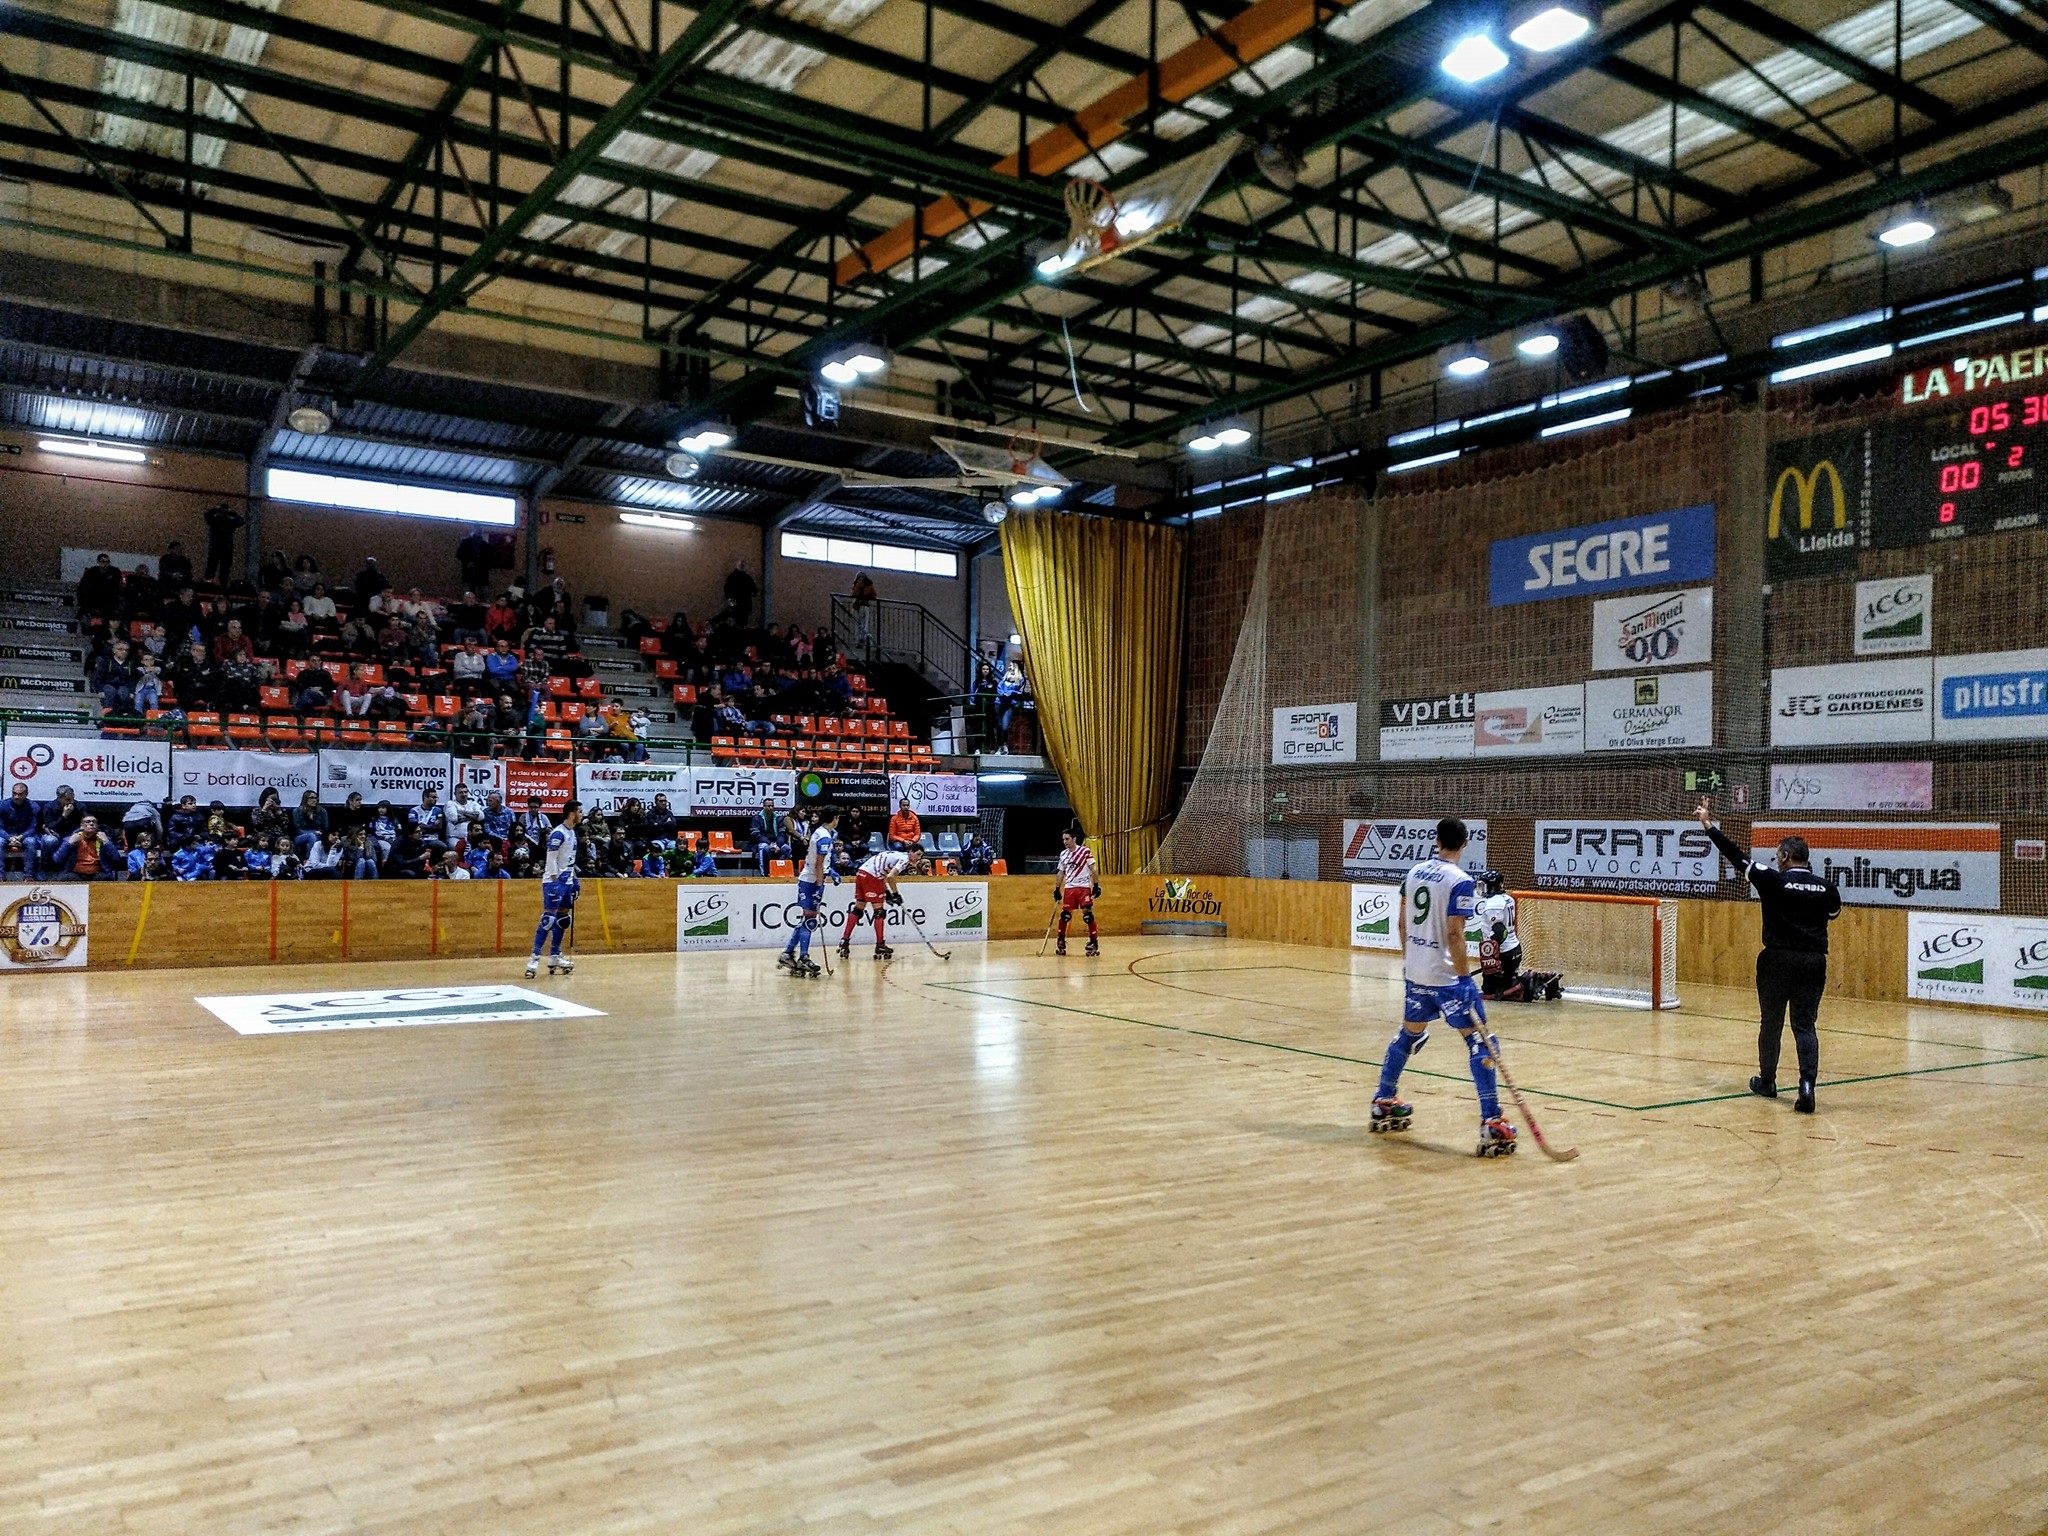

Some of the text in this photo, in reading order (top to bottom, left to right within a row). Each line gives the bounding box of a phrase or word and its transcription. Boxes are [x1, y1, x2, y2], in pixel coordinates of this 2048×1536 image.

[1902, 367, 1951, 405] LA
[1969, 402, 2011, 435] 05
[1931, 442, 1979, 462] LOCAL
[2007, 445, 2024, 468] 2
[1940, 460, 1981, 493] 00
[1799, 530, 1855, 552] Lleida
[1524, 523, 1671, 591] SEGRE
[1868, 585, 1913, 619] ICG
[20, 679, 75, 688] McDonald's
[1827, 688, 1924, 701] CONSTRUCCIONS
[1392, 692, 1475, 727] vprtt
[1612, 705, 1683, 719] GERMANOR
[1827, 698, 1924, 712] GARDENES
[1290, 712, 1331, 724] SPORT
[1624, 717, 1670, 734] Original
[1297, 740, 1344, 754] replic
[1645, 737, 1666, 747] Verge
[1667, 736, 1686, 745] Extra
[62, 753, 164, 774] batlleida
[370, 766, 447, 778] AUTOMOTOR
[93, 779, 136, 788] TUDOR
[207, 773, 308, 788] batalla cafés
[591, 768, 677, 782] MÉS ESPORT
[860, 777, 886, 785] IBÉRICA
[370, 779, 445, 791] Y SERVICIOS
[510, 789, 569, 798] 973 300 375
[695, 780, 790, 797] PRATS
[595, 797, 672, 812] La Mñaa
[699, 796, 787, 806] ADVOCAS
[1395, 825, 1487, 841] Ascers
[1542, 828, 1712, 858] PRATS
[1388, 844, 1440, 861] SALE
[1547, 858, 1703, 877] ADVOCATS
[1537, 877, 1717, 894] 973 240 564 www.pratsadvocats.com
[1824, 856, 1962, 898] inlingua
[29, 887, 52, 905] 65
[1155, 887, 1213, 900] La flor de
[23, 905, 56, 916] LLEIDA
[687, 894, 722, 920] ICG
[948, 891, 977, 914] ICG
[1148, 897, 1222, 916] VIMBODI
[1359, 894, 1385, 916] ICG
[1413, 885, 1431, 925] 9
[752, 903, 805, 930] ICG
[683, 937, 729, 945] Software
[1356, 934, 1391, 942] Software
[1922, 928, 1973, 958] ICG
[25, 949, 52, 958] anys
[2019, 940, 2048, 966] IC
[1916, 982, 1984, 994] Software
[2012, 990, 2048, 1000] Soft
